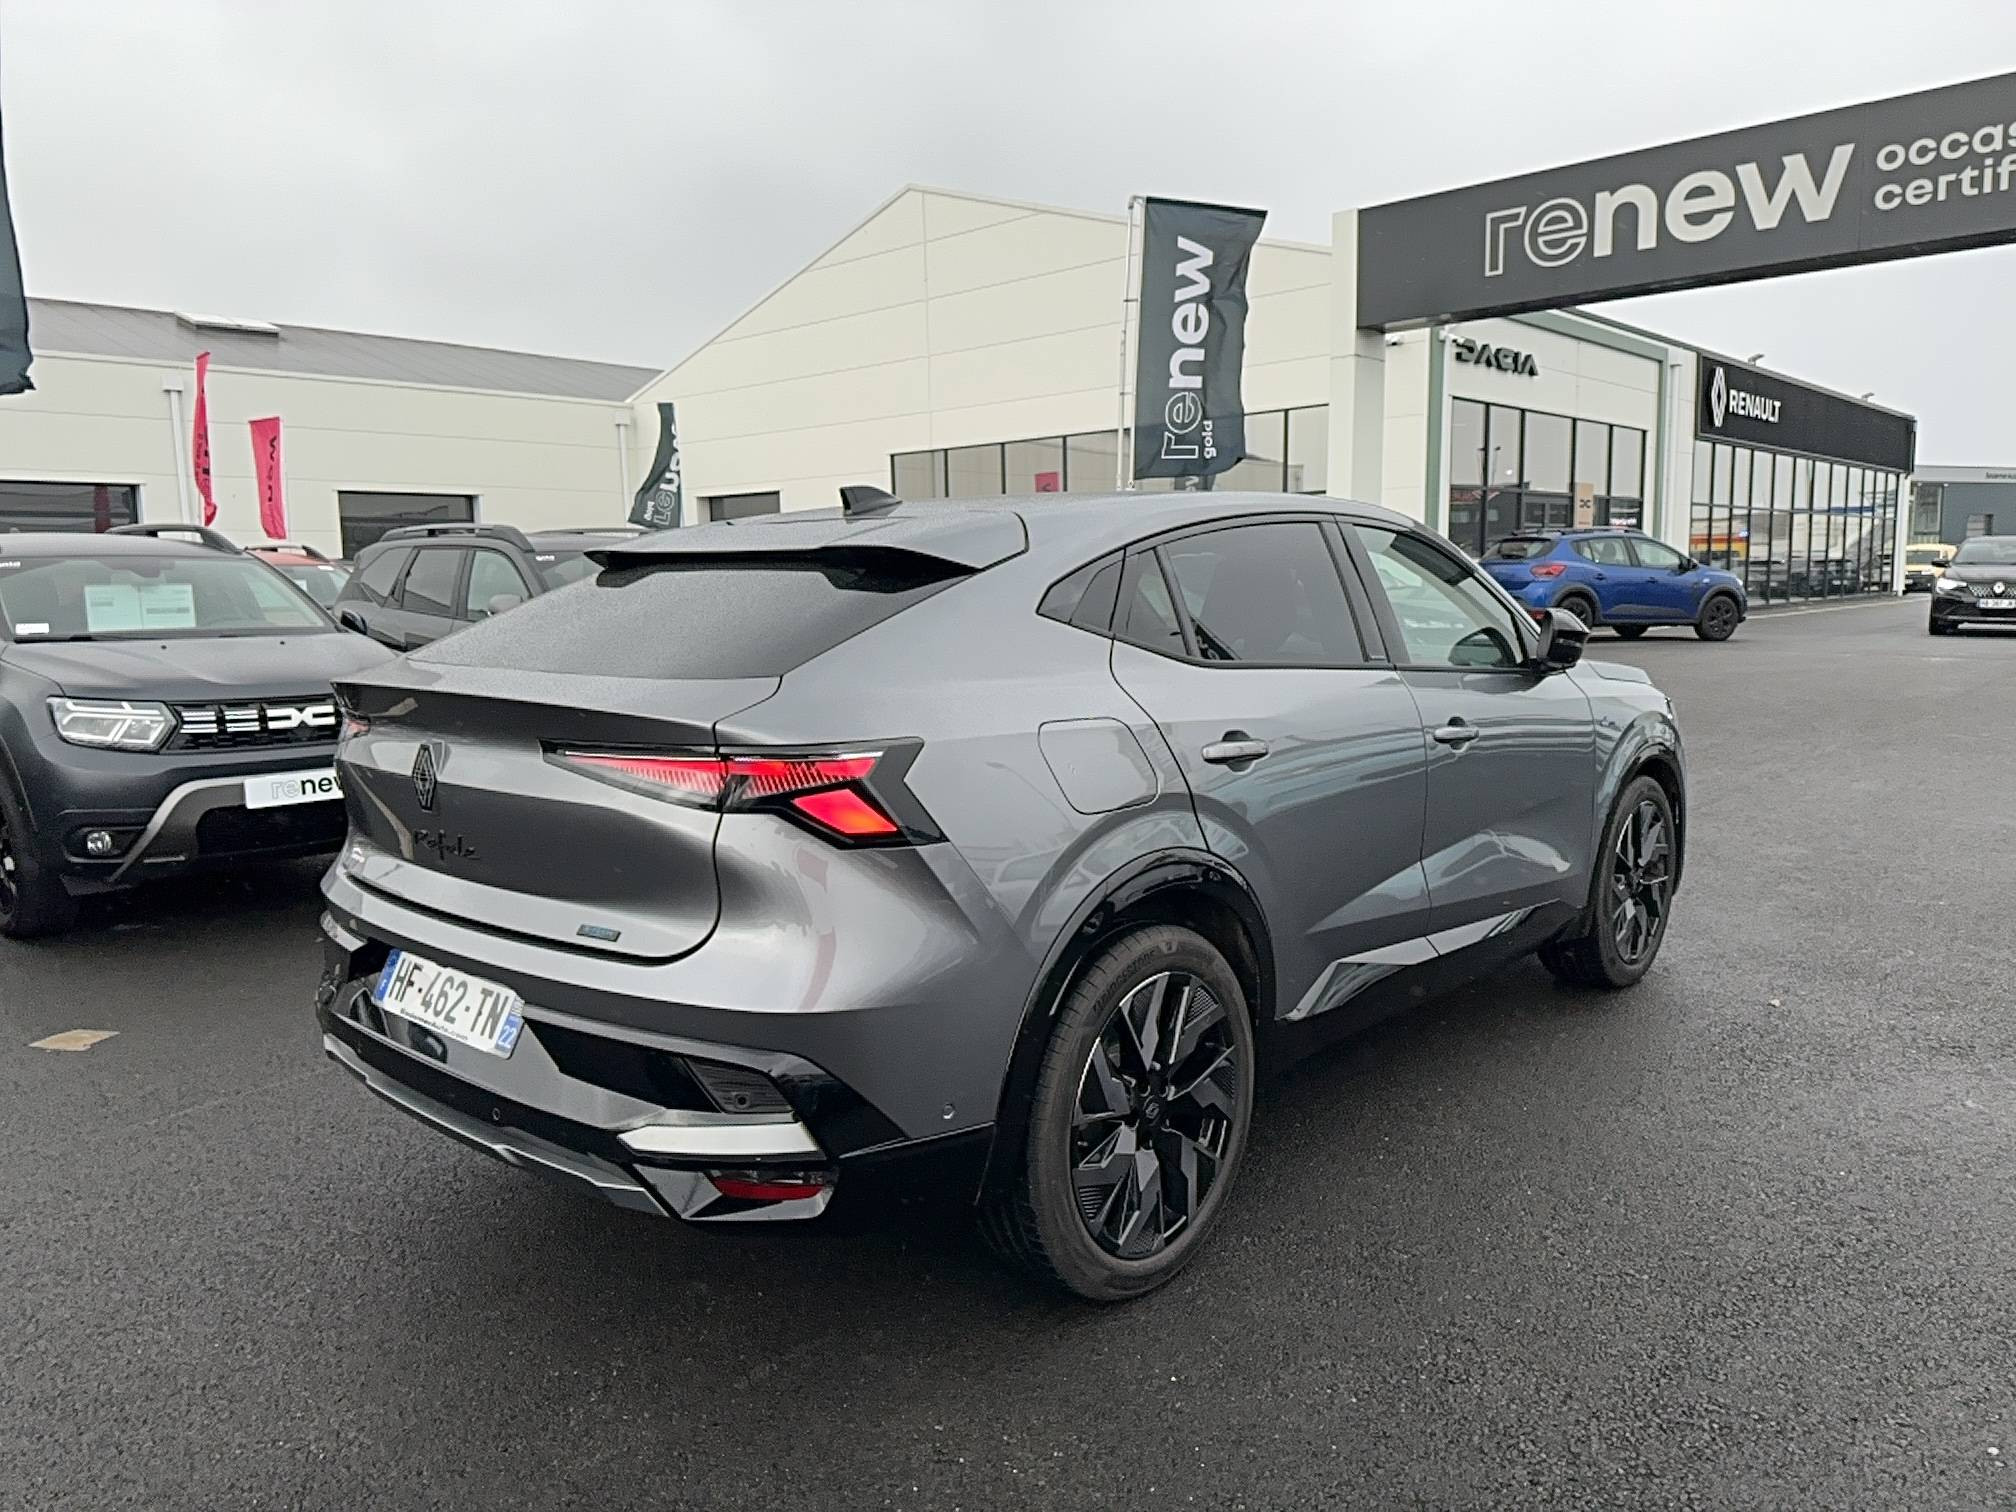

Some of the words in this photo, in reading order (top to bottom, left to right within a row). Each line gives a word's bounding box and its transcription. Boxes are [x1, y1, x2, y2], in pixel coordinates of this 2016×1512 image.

[1485, 143, 1856, 277] renew
[1161, 235, 1214, 459] renew
[1452, 335, 1539, 376] DACIA
[1728, 388, 1781, 424] RENAULT
[1202, 420, 1217, 459] gold
[388, 957, 509, 1040] HF-462-TN
[498, 1026, 518, 1049] 22
